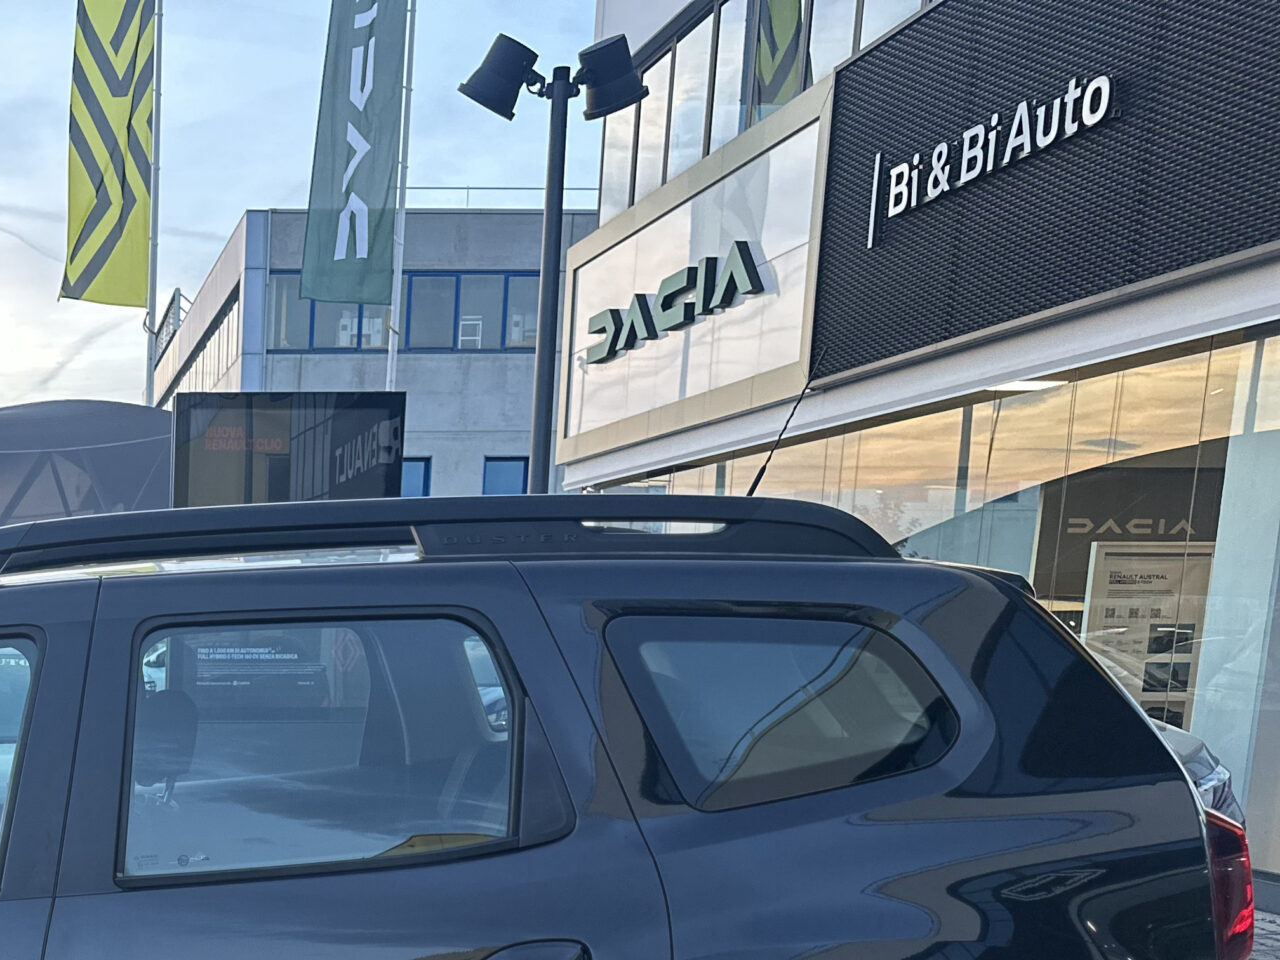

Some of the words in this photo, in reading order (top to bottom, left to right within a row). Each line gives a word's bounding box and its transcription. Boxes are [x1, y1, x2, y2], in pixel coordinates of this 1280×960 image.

[888, 153, 920, 218] Bi
[926, 142, 950, 199] &
[960, 113, 999, 184] Bi
[1003, 75, 1111, 167] Auto
[587, 241, 764, 364] DACIA
[205, 426, 244, 438] NUOVA
[255, 438, 282, 449] CLIO
[1067, 518, 1196, 534] DACIA
[442, 533, 578, 546] DUSTER
